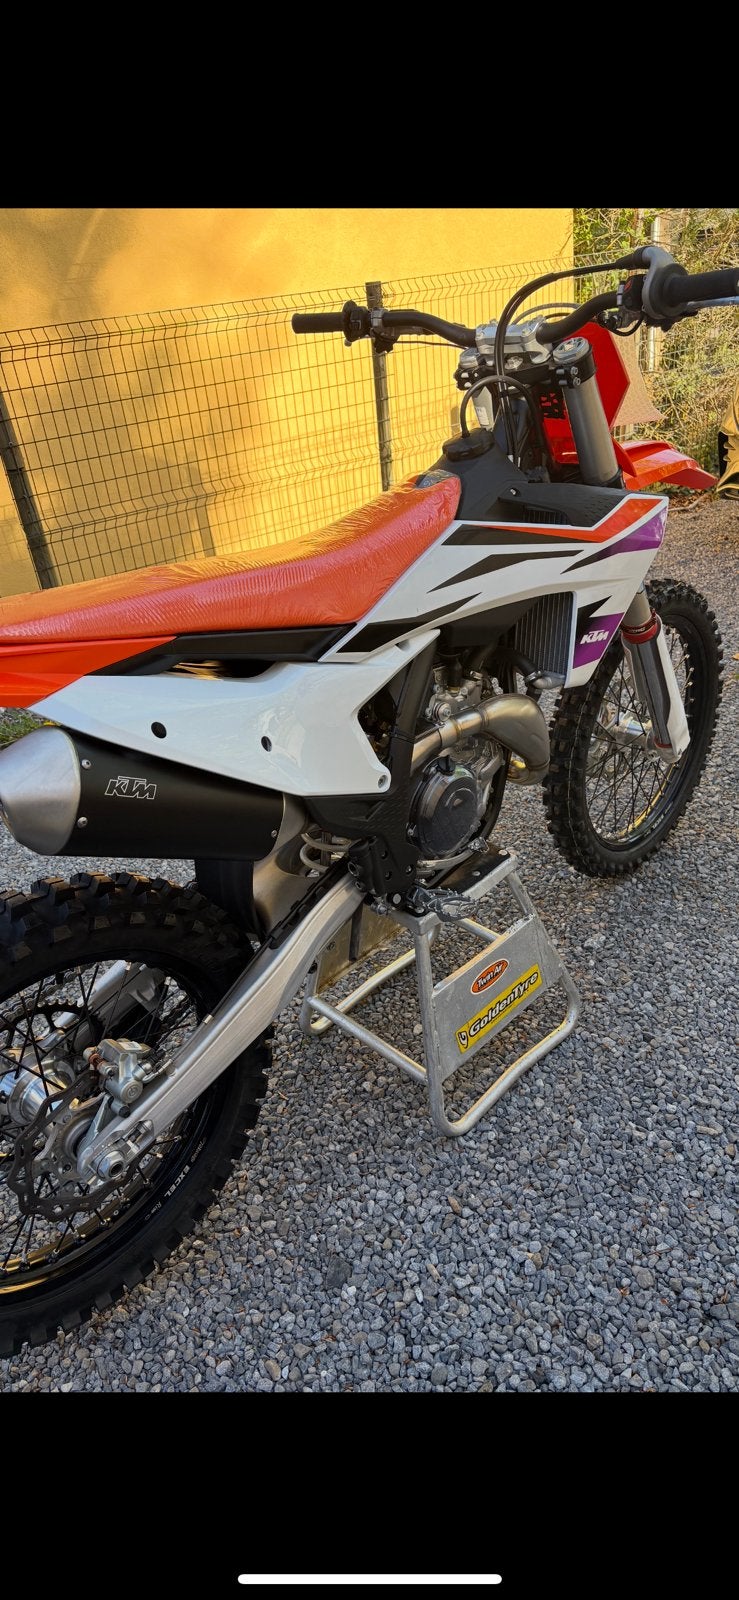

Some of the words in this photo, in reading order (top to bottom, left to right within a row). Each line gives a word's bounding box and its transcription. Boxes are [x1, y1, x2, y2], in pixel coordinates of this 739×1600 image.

[580, 629, 609, 644] KTM
[104, 775, 157, 799] KTM
[468, 971, 539, 1037] GoldenTyre
[164, 1165, 190, 1197] EXCEL
